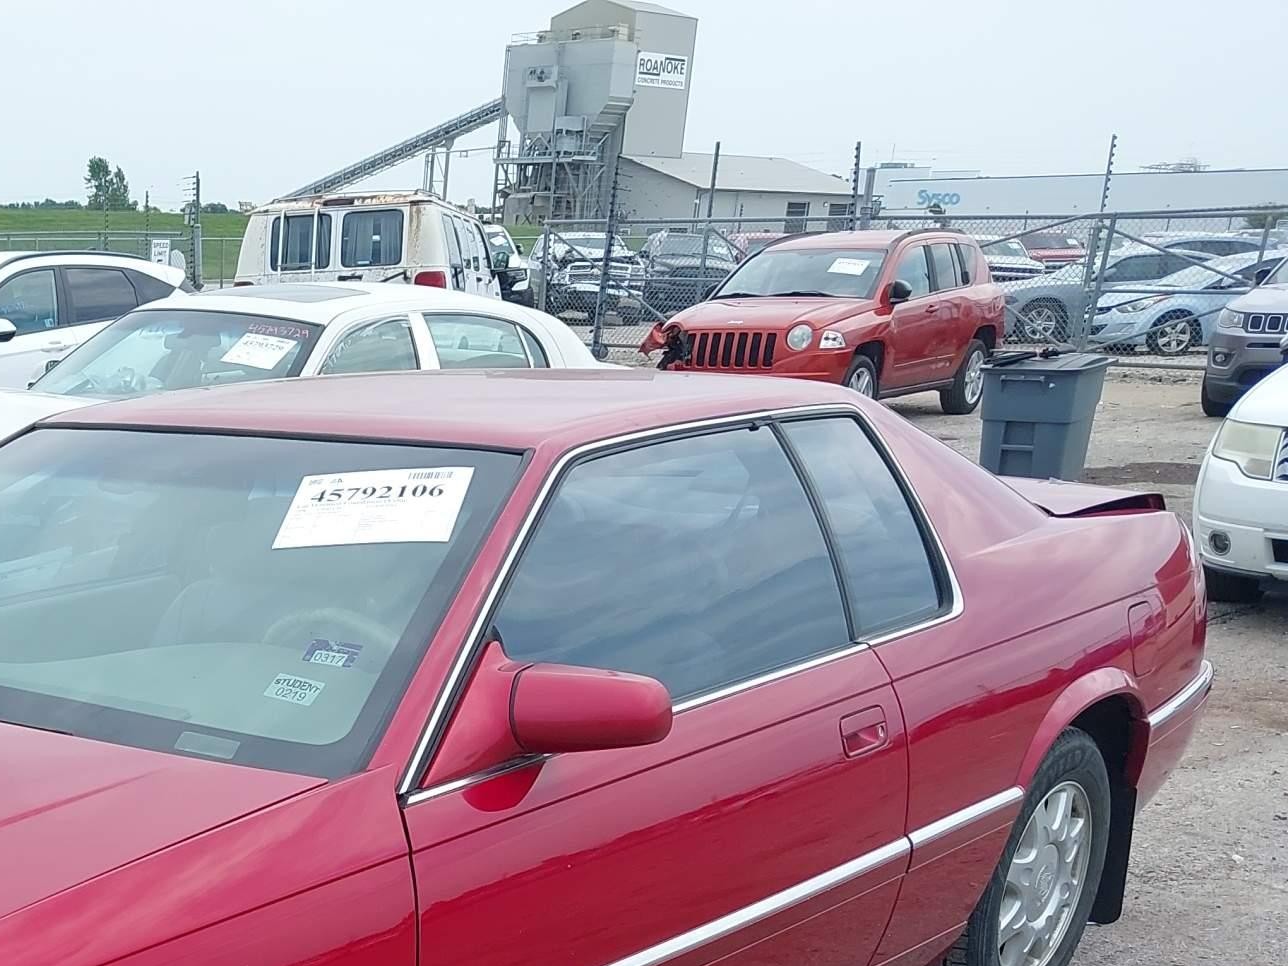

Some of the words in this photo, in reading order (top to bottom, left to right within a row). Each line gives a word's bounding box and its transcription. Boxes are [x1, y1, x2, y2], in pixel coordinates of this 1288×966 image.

[638, 57, 686, 75] ROANOKE
[916, 189, 961, 207] Sysco
[310, 483, 446, 503] 45792106
[312, 652, 346, 665] 0317
[274, 678, 321, 694] STUDENT
[275, 687, 307, 702] 0219
